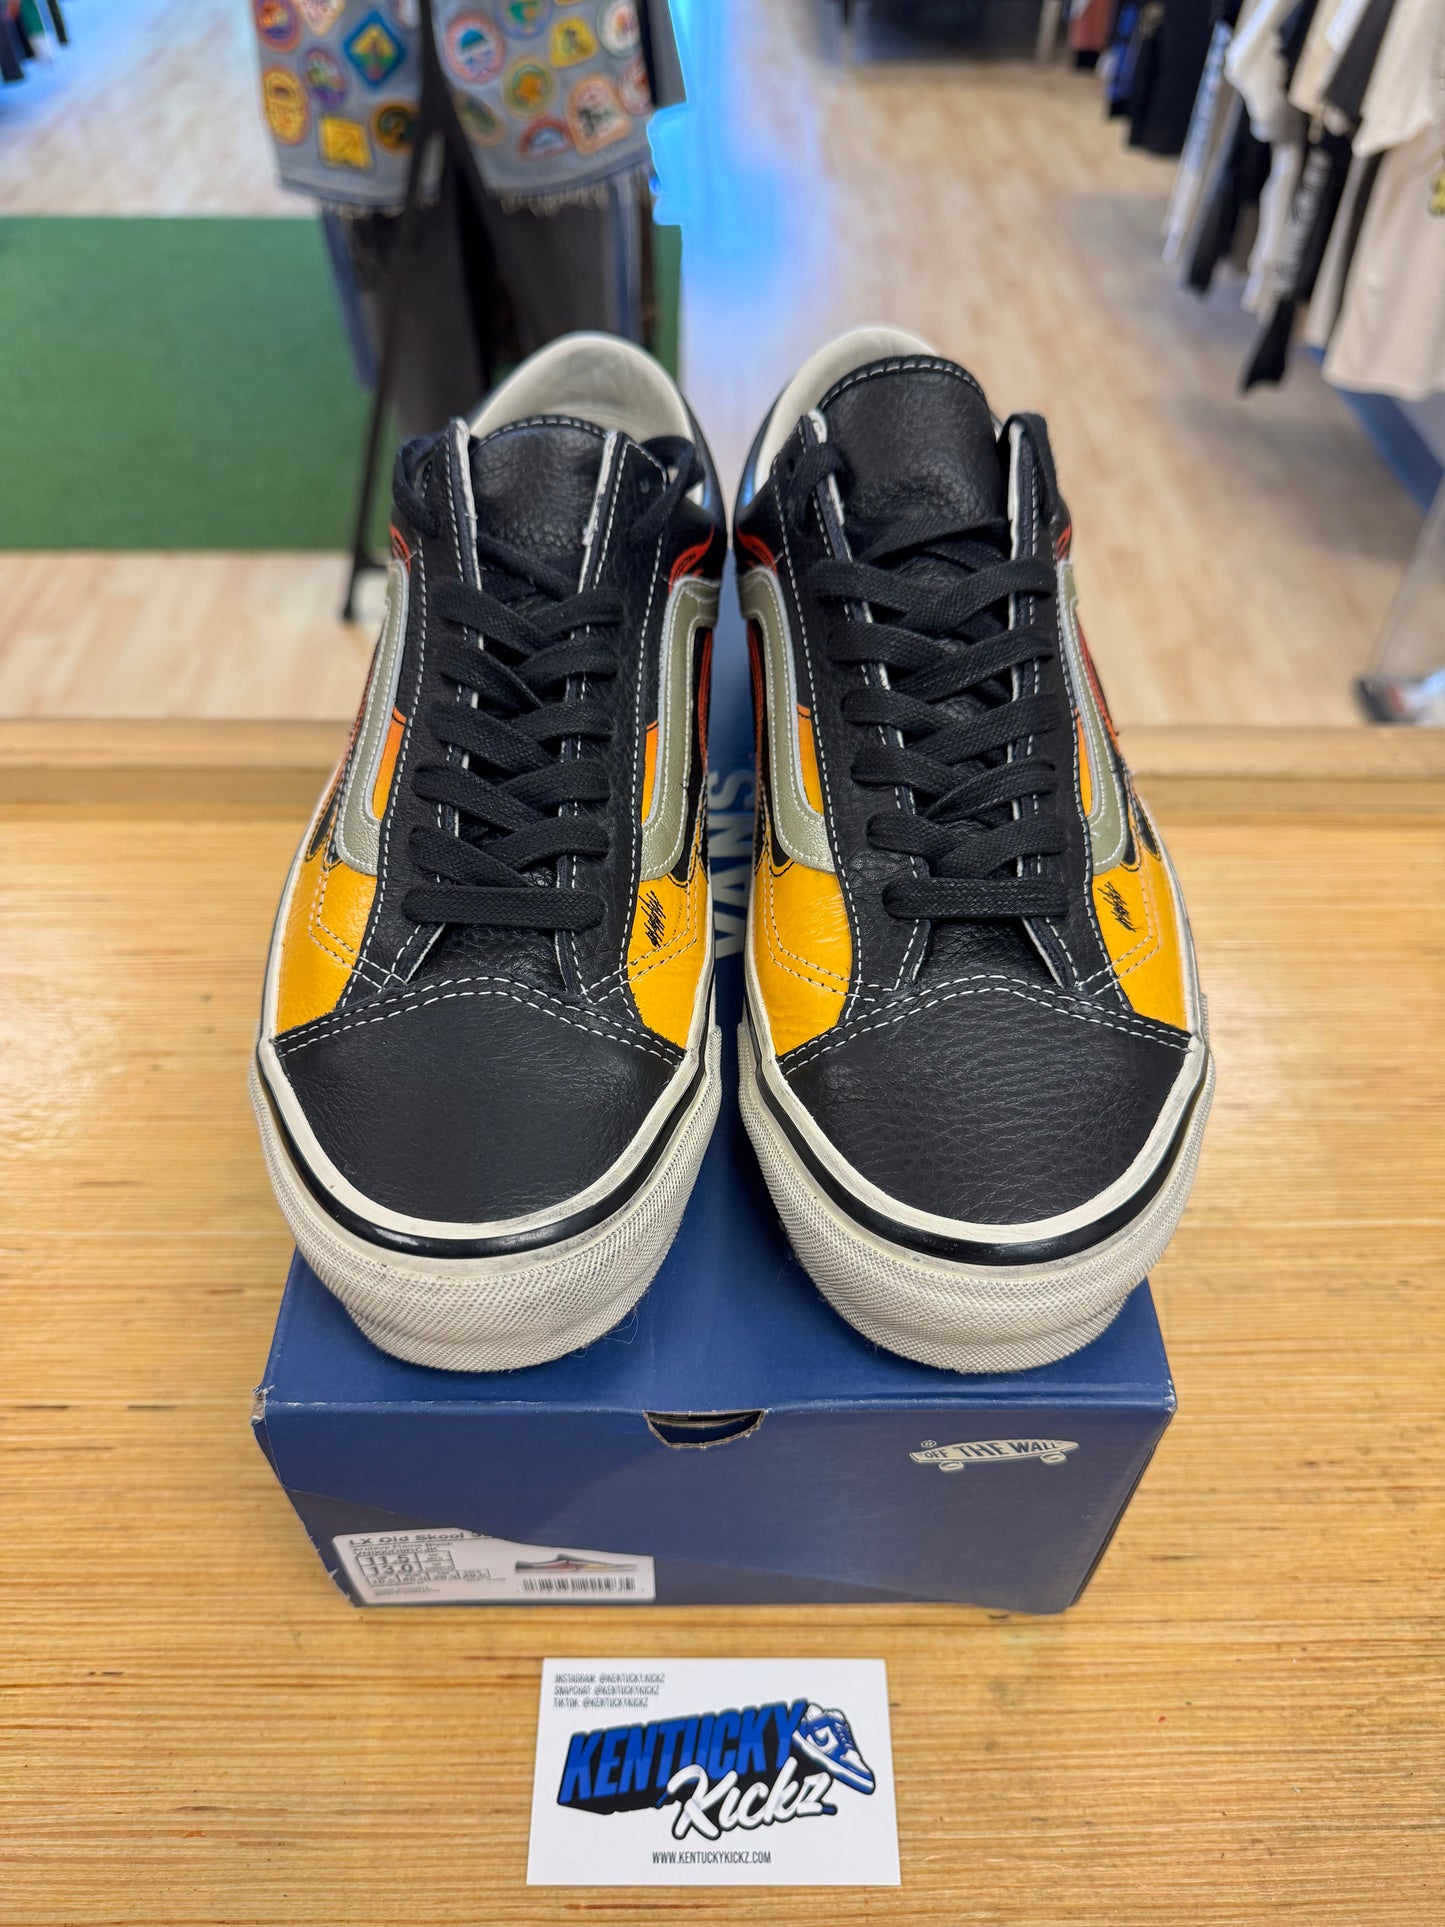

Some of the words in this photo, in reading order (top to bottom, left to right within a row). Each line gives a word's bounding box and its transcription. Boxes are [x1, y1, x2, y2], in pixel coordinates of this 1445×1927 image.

[707, 769, 756, 960] VANS
[952, 1441, 1009, 1459] THE
[350, 1537, 372, 1546] LX
[379, 1534, 409, 1543] Old
[416, 1532, 465, 1542] Skool
[365, 1554, 411, 1566] 11.5
[367, 1563, 414, 1575] 13.0
[557, 1698, 809, 1809] KENTUCKY
[666, 1756, 838, 1840] Kickz
[652, 1851, 771, 1864] WWW.KENTUCKYKICKZ.COM
